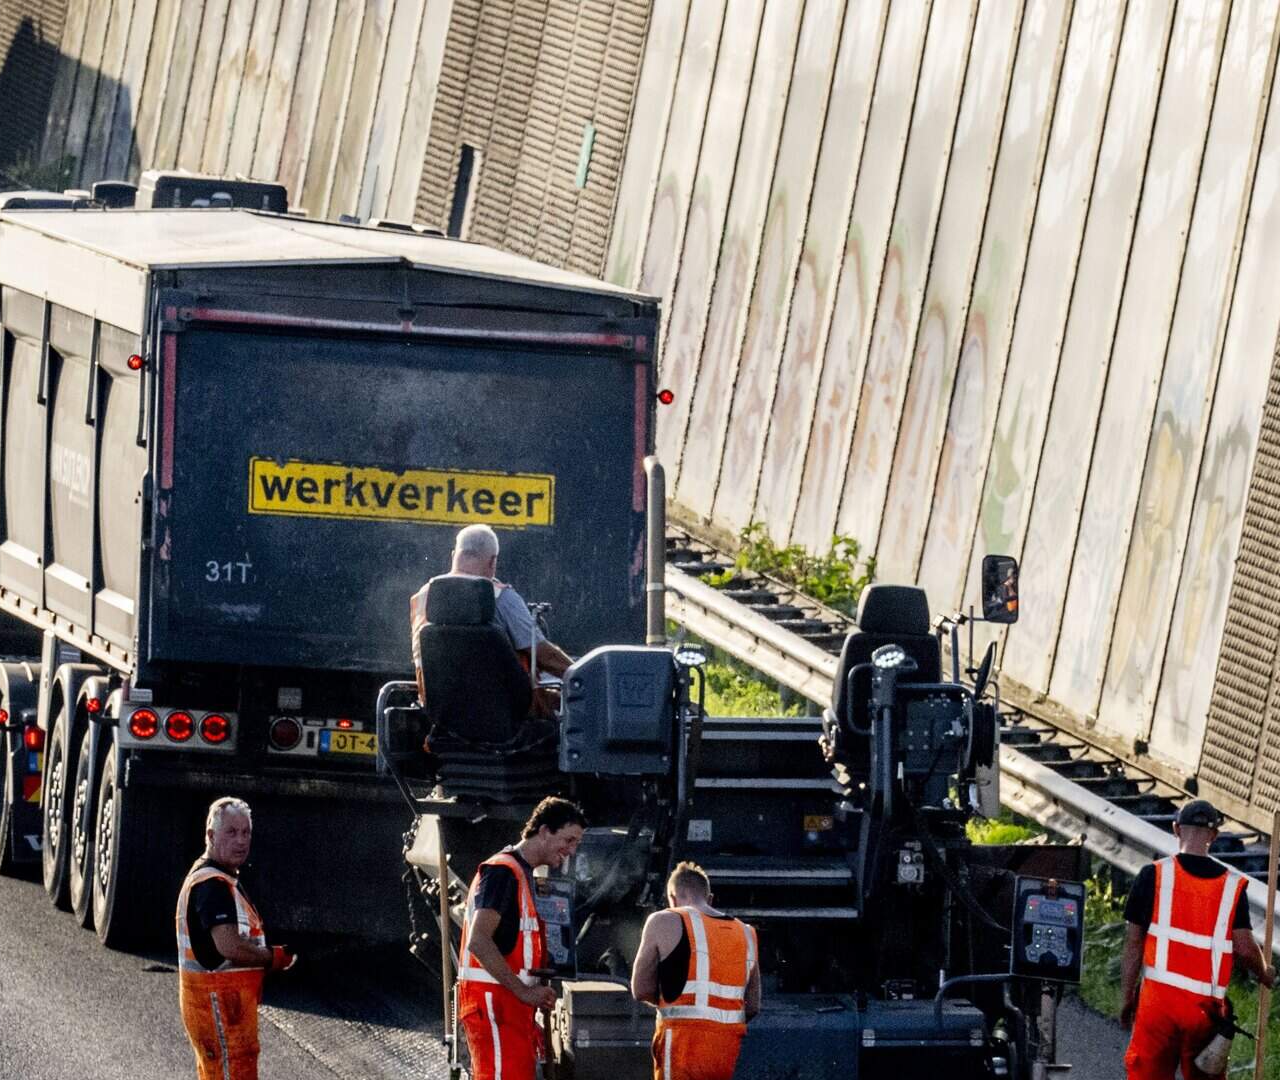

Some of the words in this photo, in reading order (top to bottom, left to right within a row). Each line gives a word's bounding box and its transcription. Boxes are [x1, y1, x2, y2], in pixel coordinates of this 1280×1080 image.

[260, 472, 545, 517] werkverkeer
[205, 560, 253, 583] 31T
[336, 734, 376, 751] OT-4
